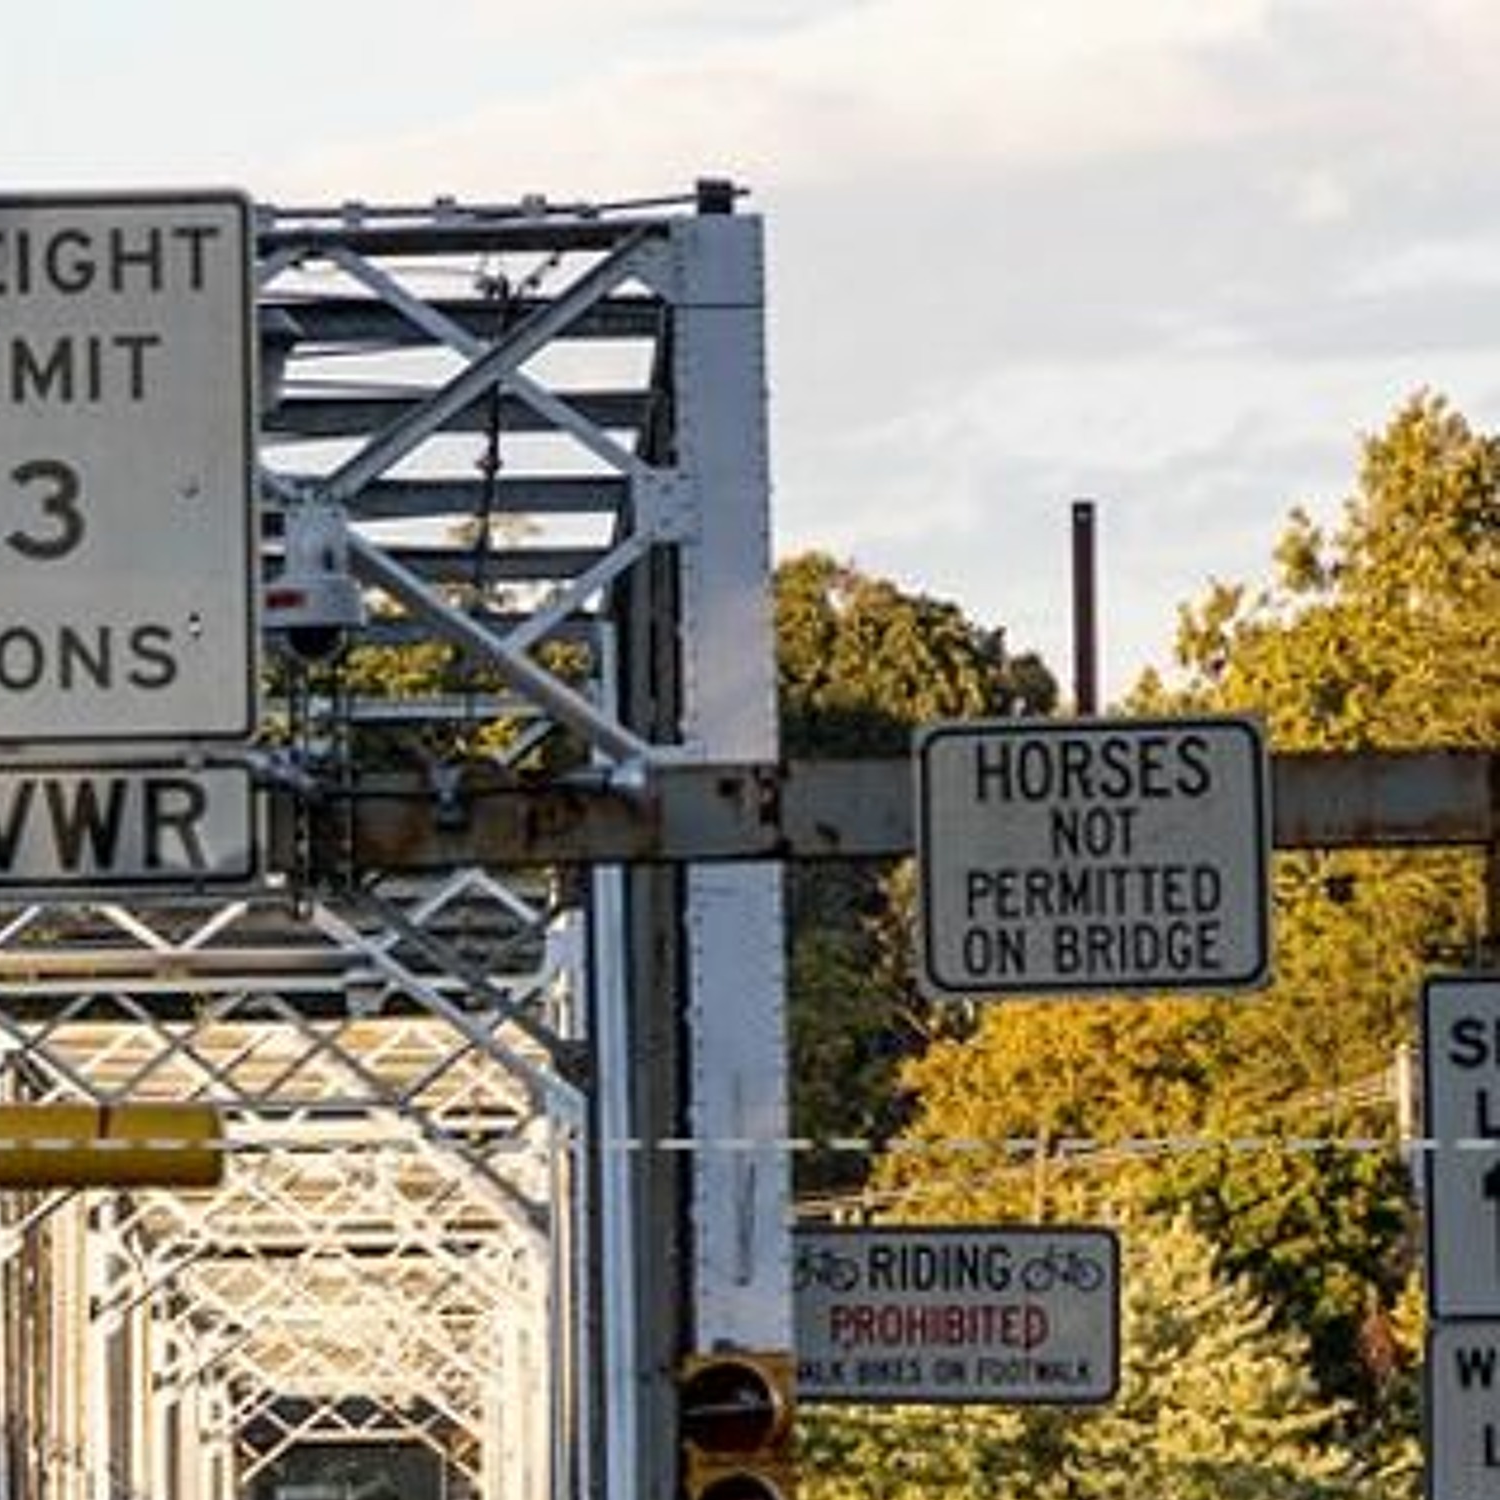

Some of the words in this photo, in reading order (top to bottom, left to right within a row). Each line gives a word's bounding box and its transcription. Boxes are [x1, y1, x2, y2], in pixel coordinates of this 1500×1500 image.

[5, 458, 86, 561] 3
[976, 736, 1211, 801] HORSES
[1051, 806, 1137, 857] NOT
[966, 864, 1222, 918] PERMITTED
[963, 927, 1026, 977] ON
[1054, 920, 1222, 974] BRIDGE
[867, 1246, 1012, 1291] RIDING
[830, 1305, 1050, 1347] PROHIBITED
